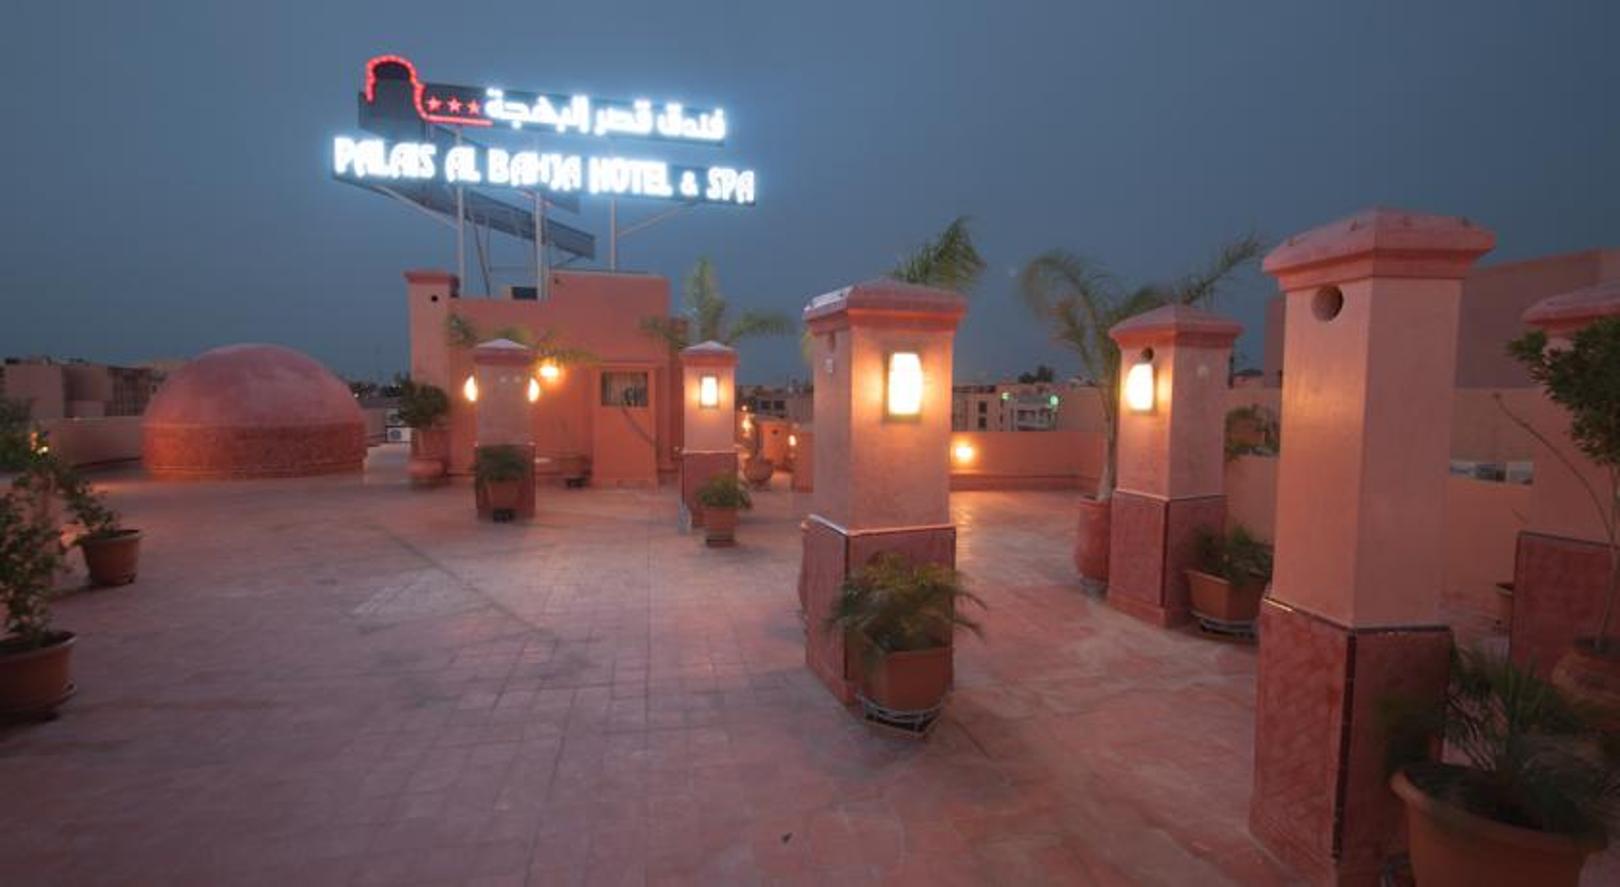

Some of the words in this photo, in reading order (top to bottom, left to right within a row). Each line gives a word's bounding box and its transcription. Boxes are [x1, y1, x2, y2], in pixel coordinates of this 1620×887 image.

[484, 87, 590, 134] البهجة
[593, 98, 653, 136] قصر
[657, 102, 726, 140] فندق
[333, 136, 436, 178] PALAIS
[444, 146, 481, 182] AL
[487, 147, 582, 192] BAHJA
[588, 157, 674, 197] HOTEL
[679, 170, 699, 196] &
[706, 166, 755, 204] SPA
